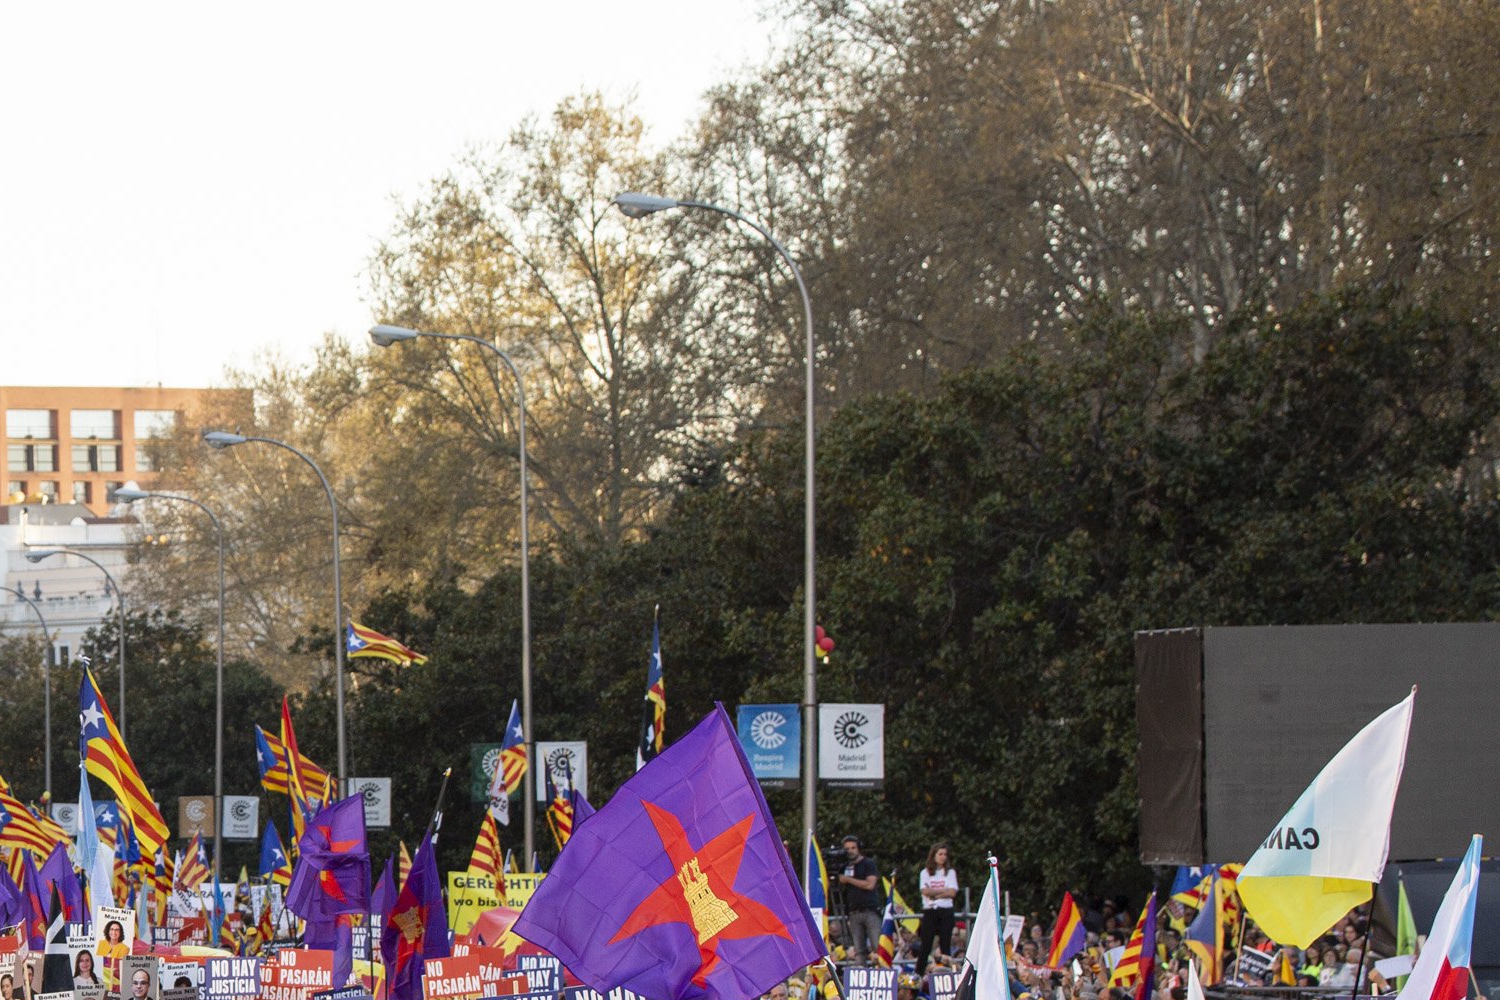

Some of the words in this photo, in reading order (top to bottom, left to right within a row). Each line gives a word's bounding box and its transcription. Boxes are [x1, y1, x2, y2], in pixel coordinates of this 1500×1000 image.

[838, 753, 866, 762] Madrid
[837, 763, 867, 771] Central
[454, 898, 474, 907] wo
[509, 897, 523, 907] du
[104, 914, 128, 922] Marta!
[281, 951, 296, 967] NO
[212, 960, 230, 977] NO
[233, 960, 255, 976] HAY
[280, 967, 331, 985] PASARÁN
[427, 962, 443, 978] NO
[209, 977, 256, 994] JUSTÍCIA
[429, 973, 481, 996] PASARÁN
[849, 970, 868, 987] NO
[872, 970, 895, 988] HAY
